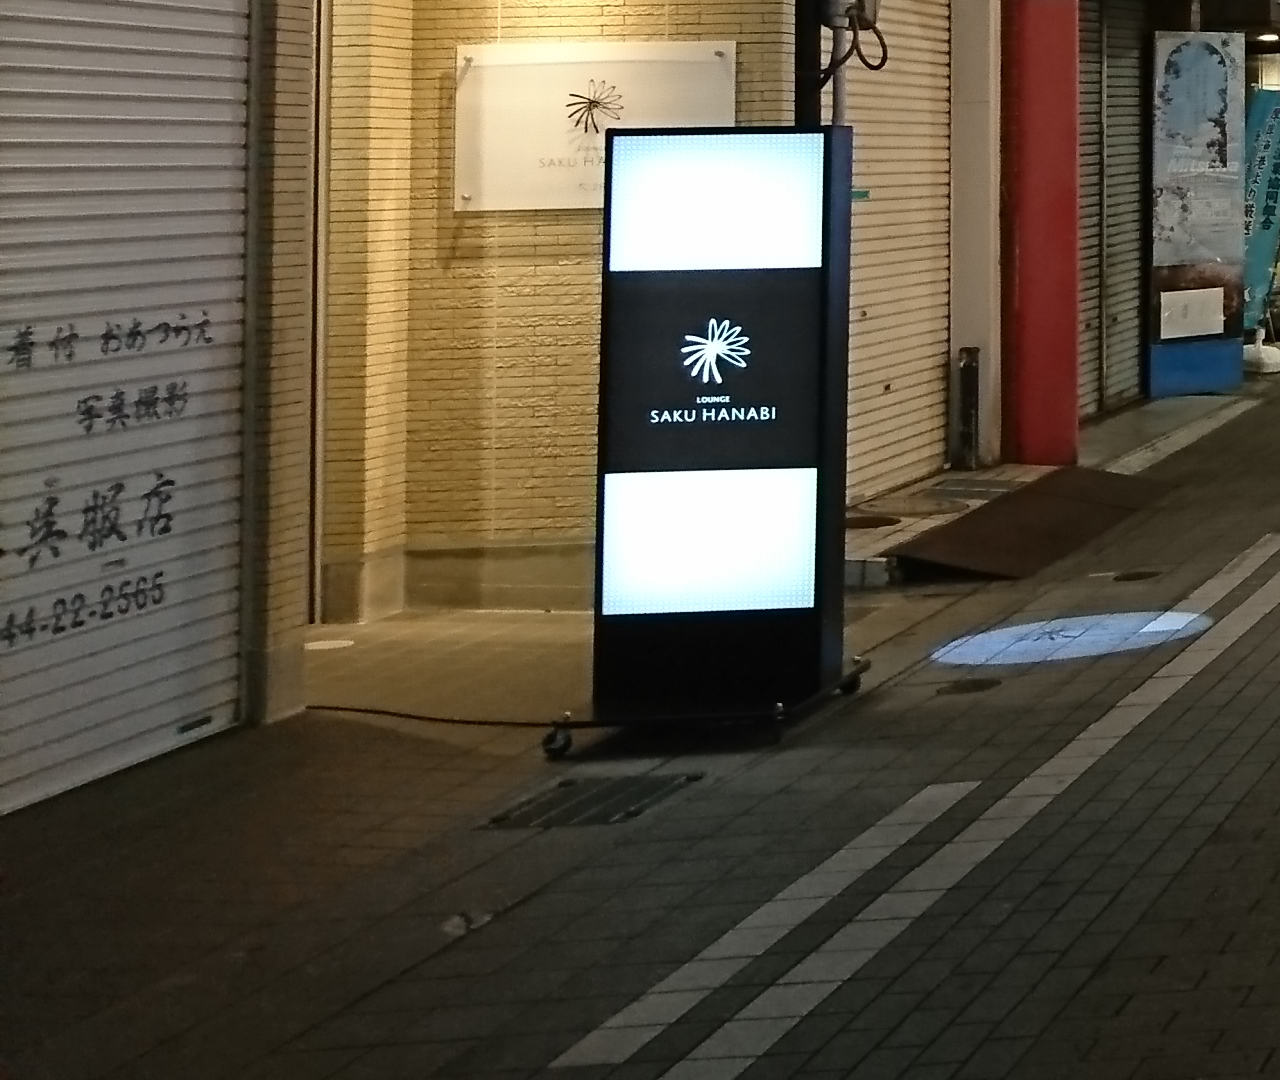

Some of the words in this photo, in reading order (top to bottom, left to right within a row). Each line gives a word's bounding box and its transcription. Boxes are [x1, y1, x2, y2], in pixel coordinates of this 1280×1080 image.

[696, 395, 731, 404] LOUNGE
[650, 409, 697, 423] SAKU
[702, 406, 776, 421] HANABI
